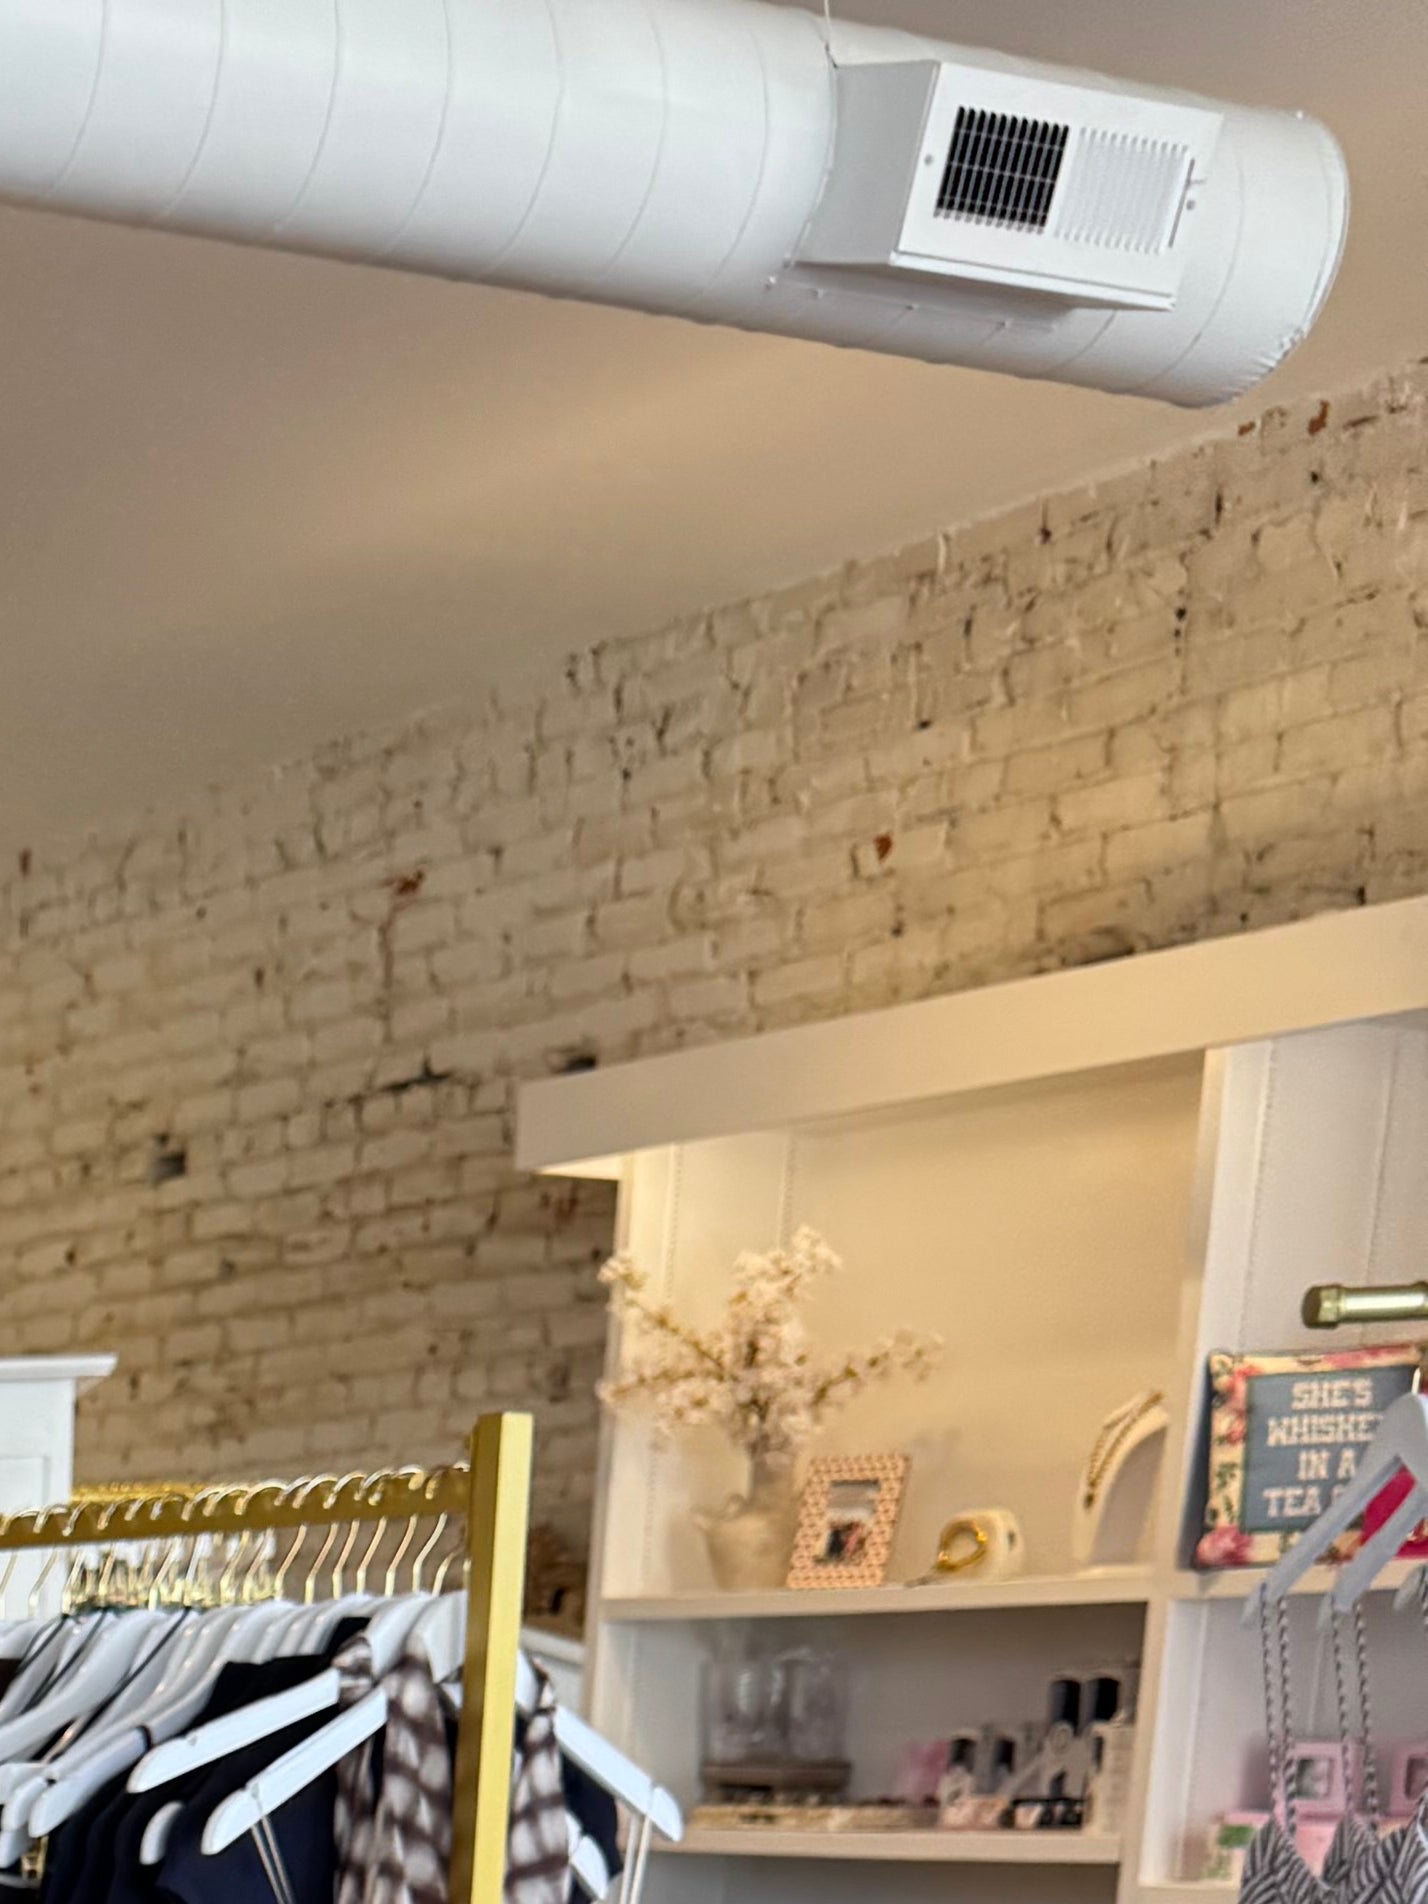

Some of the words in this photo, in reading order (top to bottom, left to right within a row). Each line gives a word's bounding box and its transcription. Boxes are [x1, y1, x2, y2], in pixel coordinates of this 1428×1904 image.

[1291, 1375, 1374, 1411] SHE'S
[1266, 1410, 1385, 1448] WHISKE
[1296, 1449, 1332, 1482] IN
[1335, 1446, 1357, 1480] A
[1261, 1483, 1322, 1519] TEA
